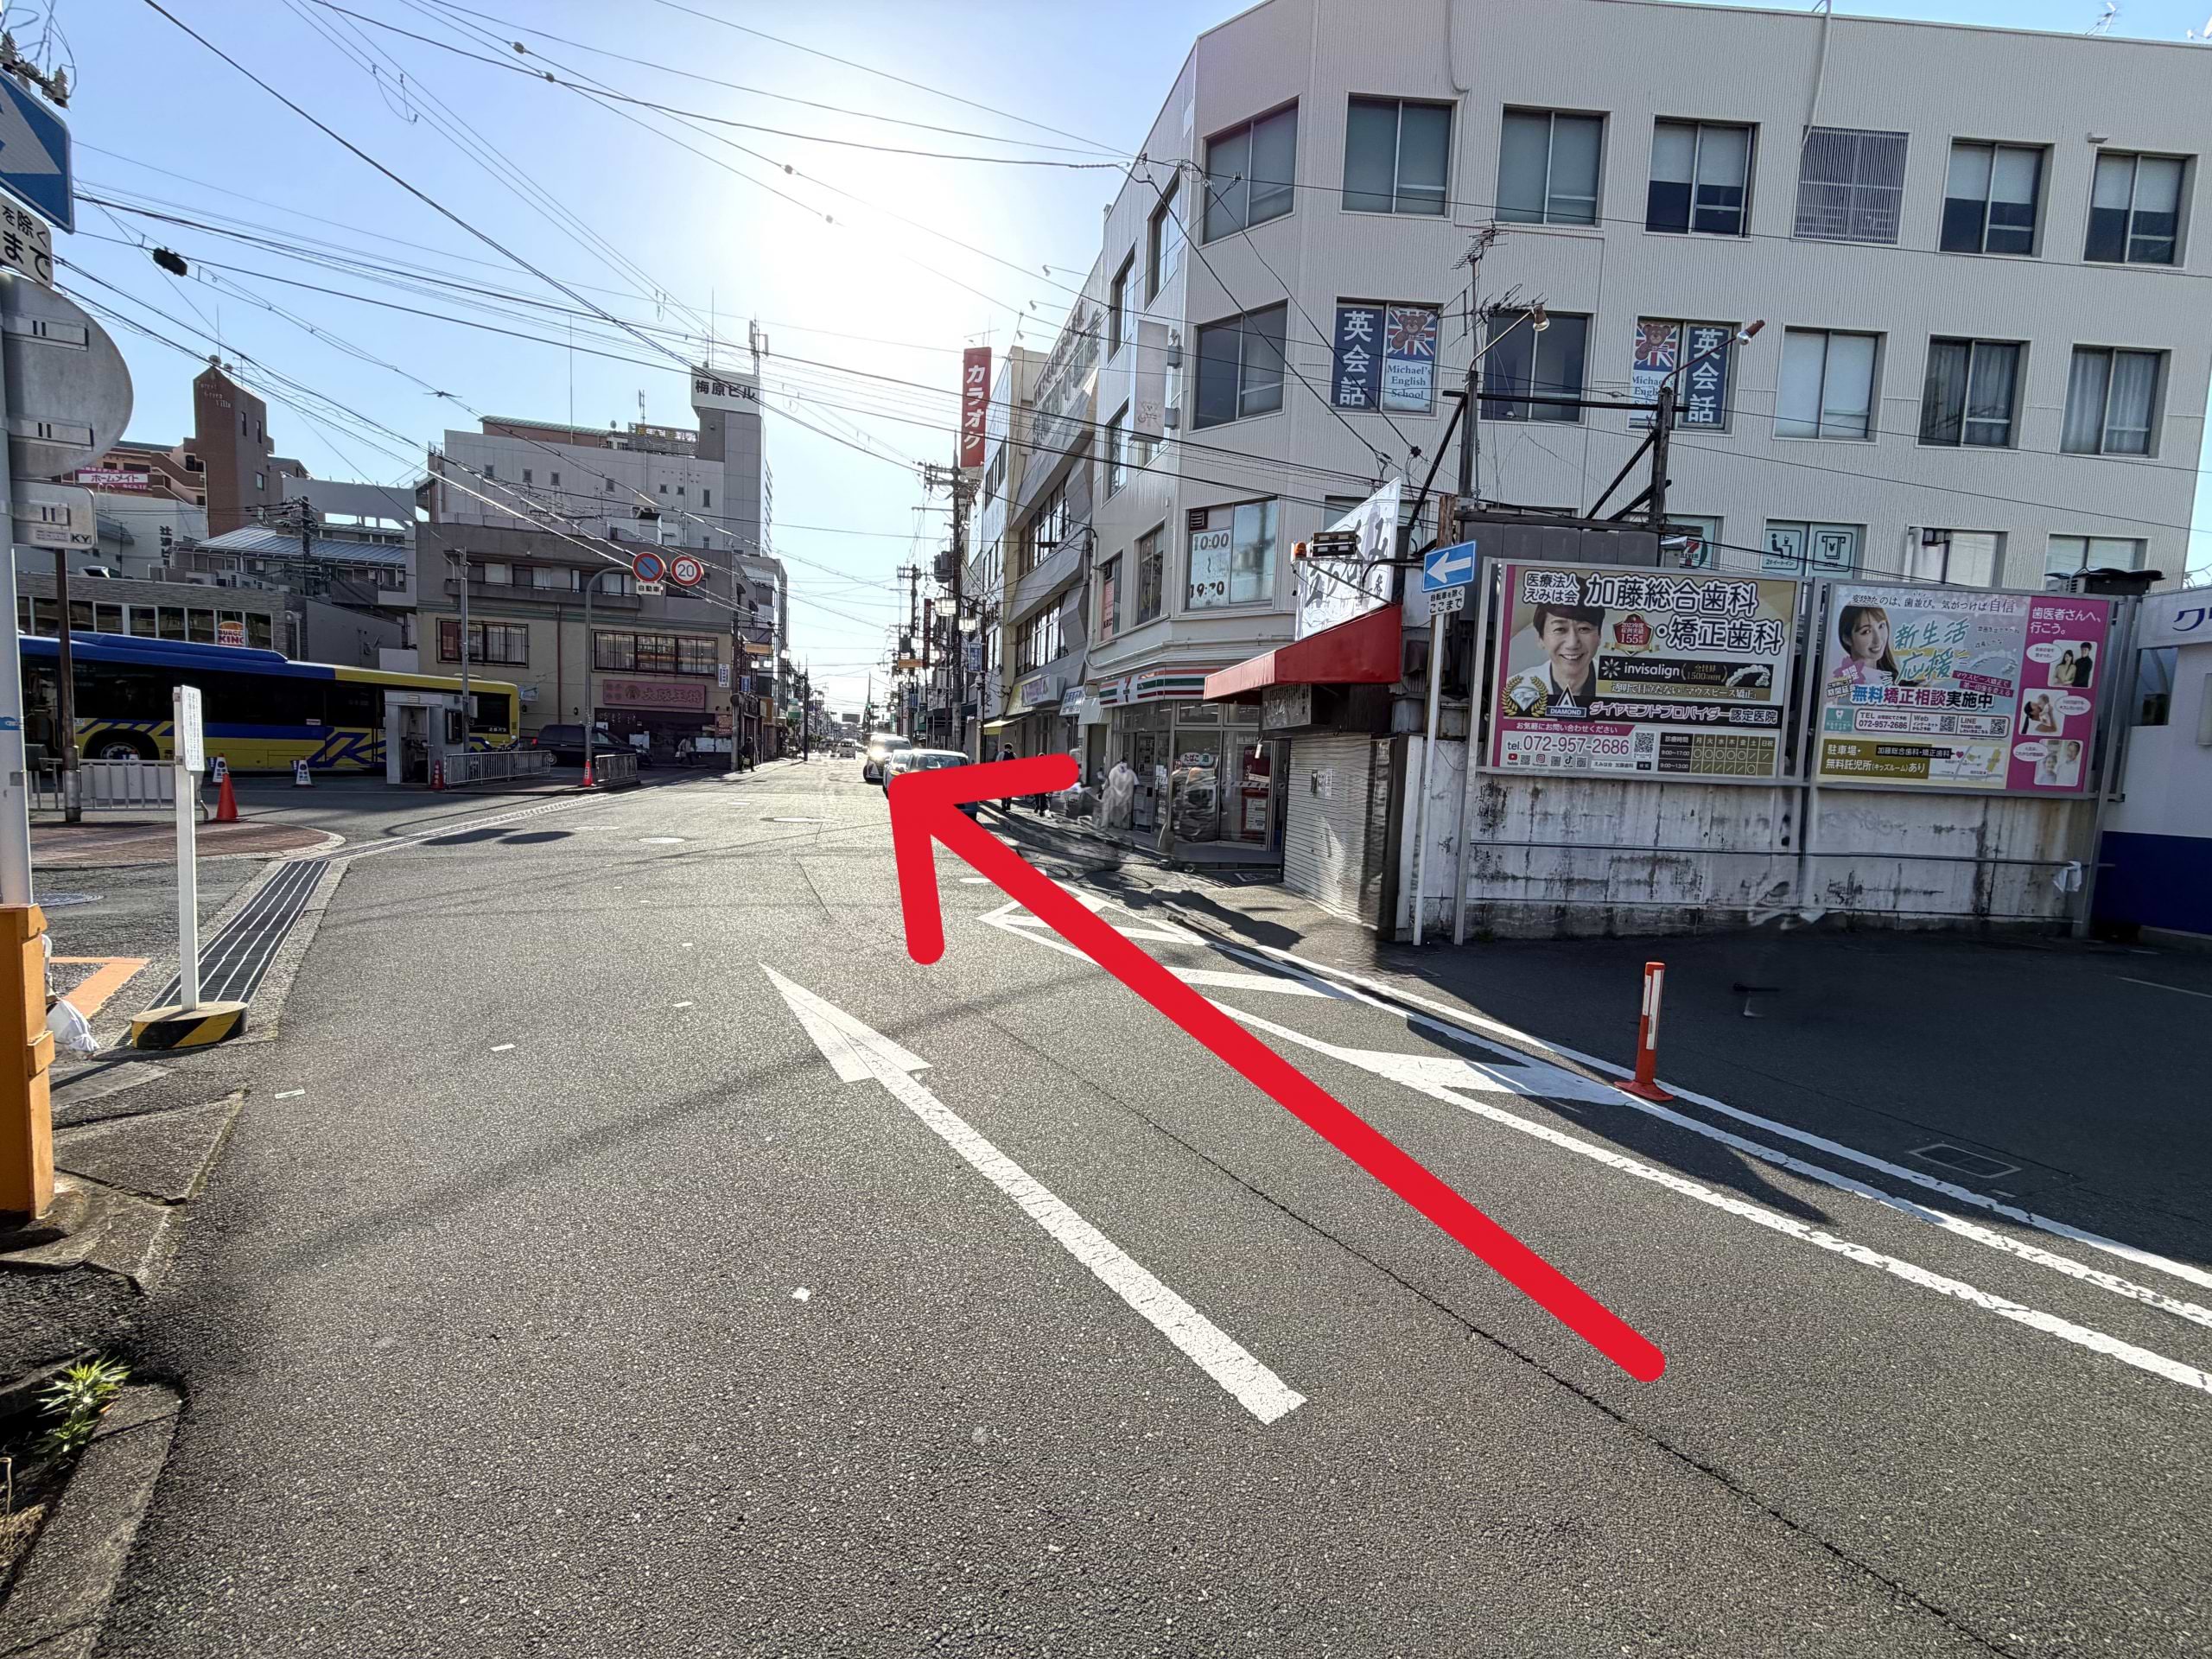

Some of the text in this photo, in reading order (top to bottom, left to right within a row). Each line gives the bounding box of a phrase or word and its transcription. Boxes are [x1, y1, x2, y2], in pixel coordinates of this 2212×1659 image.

[2, 205, 47, 248] を除く
[3, 230, 51, 281] まで
[1340, 311, 1374, 406] 英会話
[1388, 365, 1432, 375] Michael's
[1688, 328, 1723, 423] 英会話
[1391, 376, 1426, 386] English
[1632, 376, 1674, 385] Micha's
[696, 379, 756, 399] 梅原ビル
[1391, 390, 1424, 398] School
[1634, 387, 1660, 397] Engli
[963, 365, 986, 449] カラオケ
[91, 474, 138, 483] ホームメイト
[72, 534, 89, 543] KY
[1193, 532, 1230, 551] 10:00
[677, 564, 695, 577] 20
[1527, 573, 1579, 588] 医療法人
[1431, 588, 1463, 601] 自転車を除く
[1526, 588, 1578, 603] えみは会
[1586, 575, 1755, 615] 加藤総合歯科
[1430, 598, 1462, 613] ここまで
[2032, 607, 2101, 622] 歯医者さんへ、
[2172, 607, 2212, 632] ク
[219, 629, 244, 638] BURGE
[1895, 618, 1970, 650] 新生活
[2031, 621, 2065, 634] 行こう。
[1621, 633, 1639, 644] 155
[1624, 662, 1680, 679] invisalign
[1897, 650, 1955, 685] 応援
[1851, 685, 1993, 709] 無料矯正相談実施中
[1589, 701, 1777, 724] ダイヤモンドプロバイダー認定医院
[1516, 722, 1618, 734] お気軽にお問い合わせください
[1859, 720, 1908, 729] 072-957-2686
